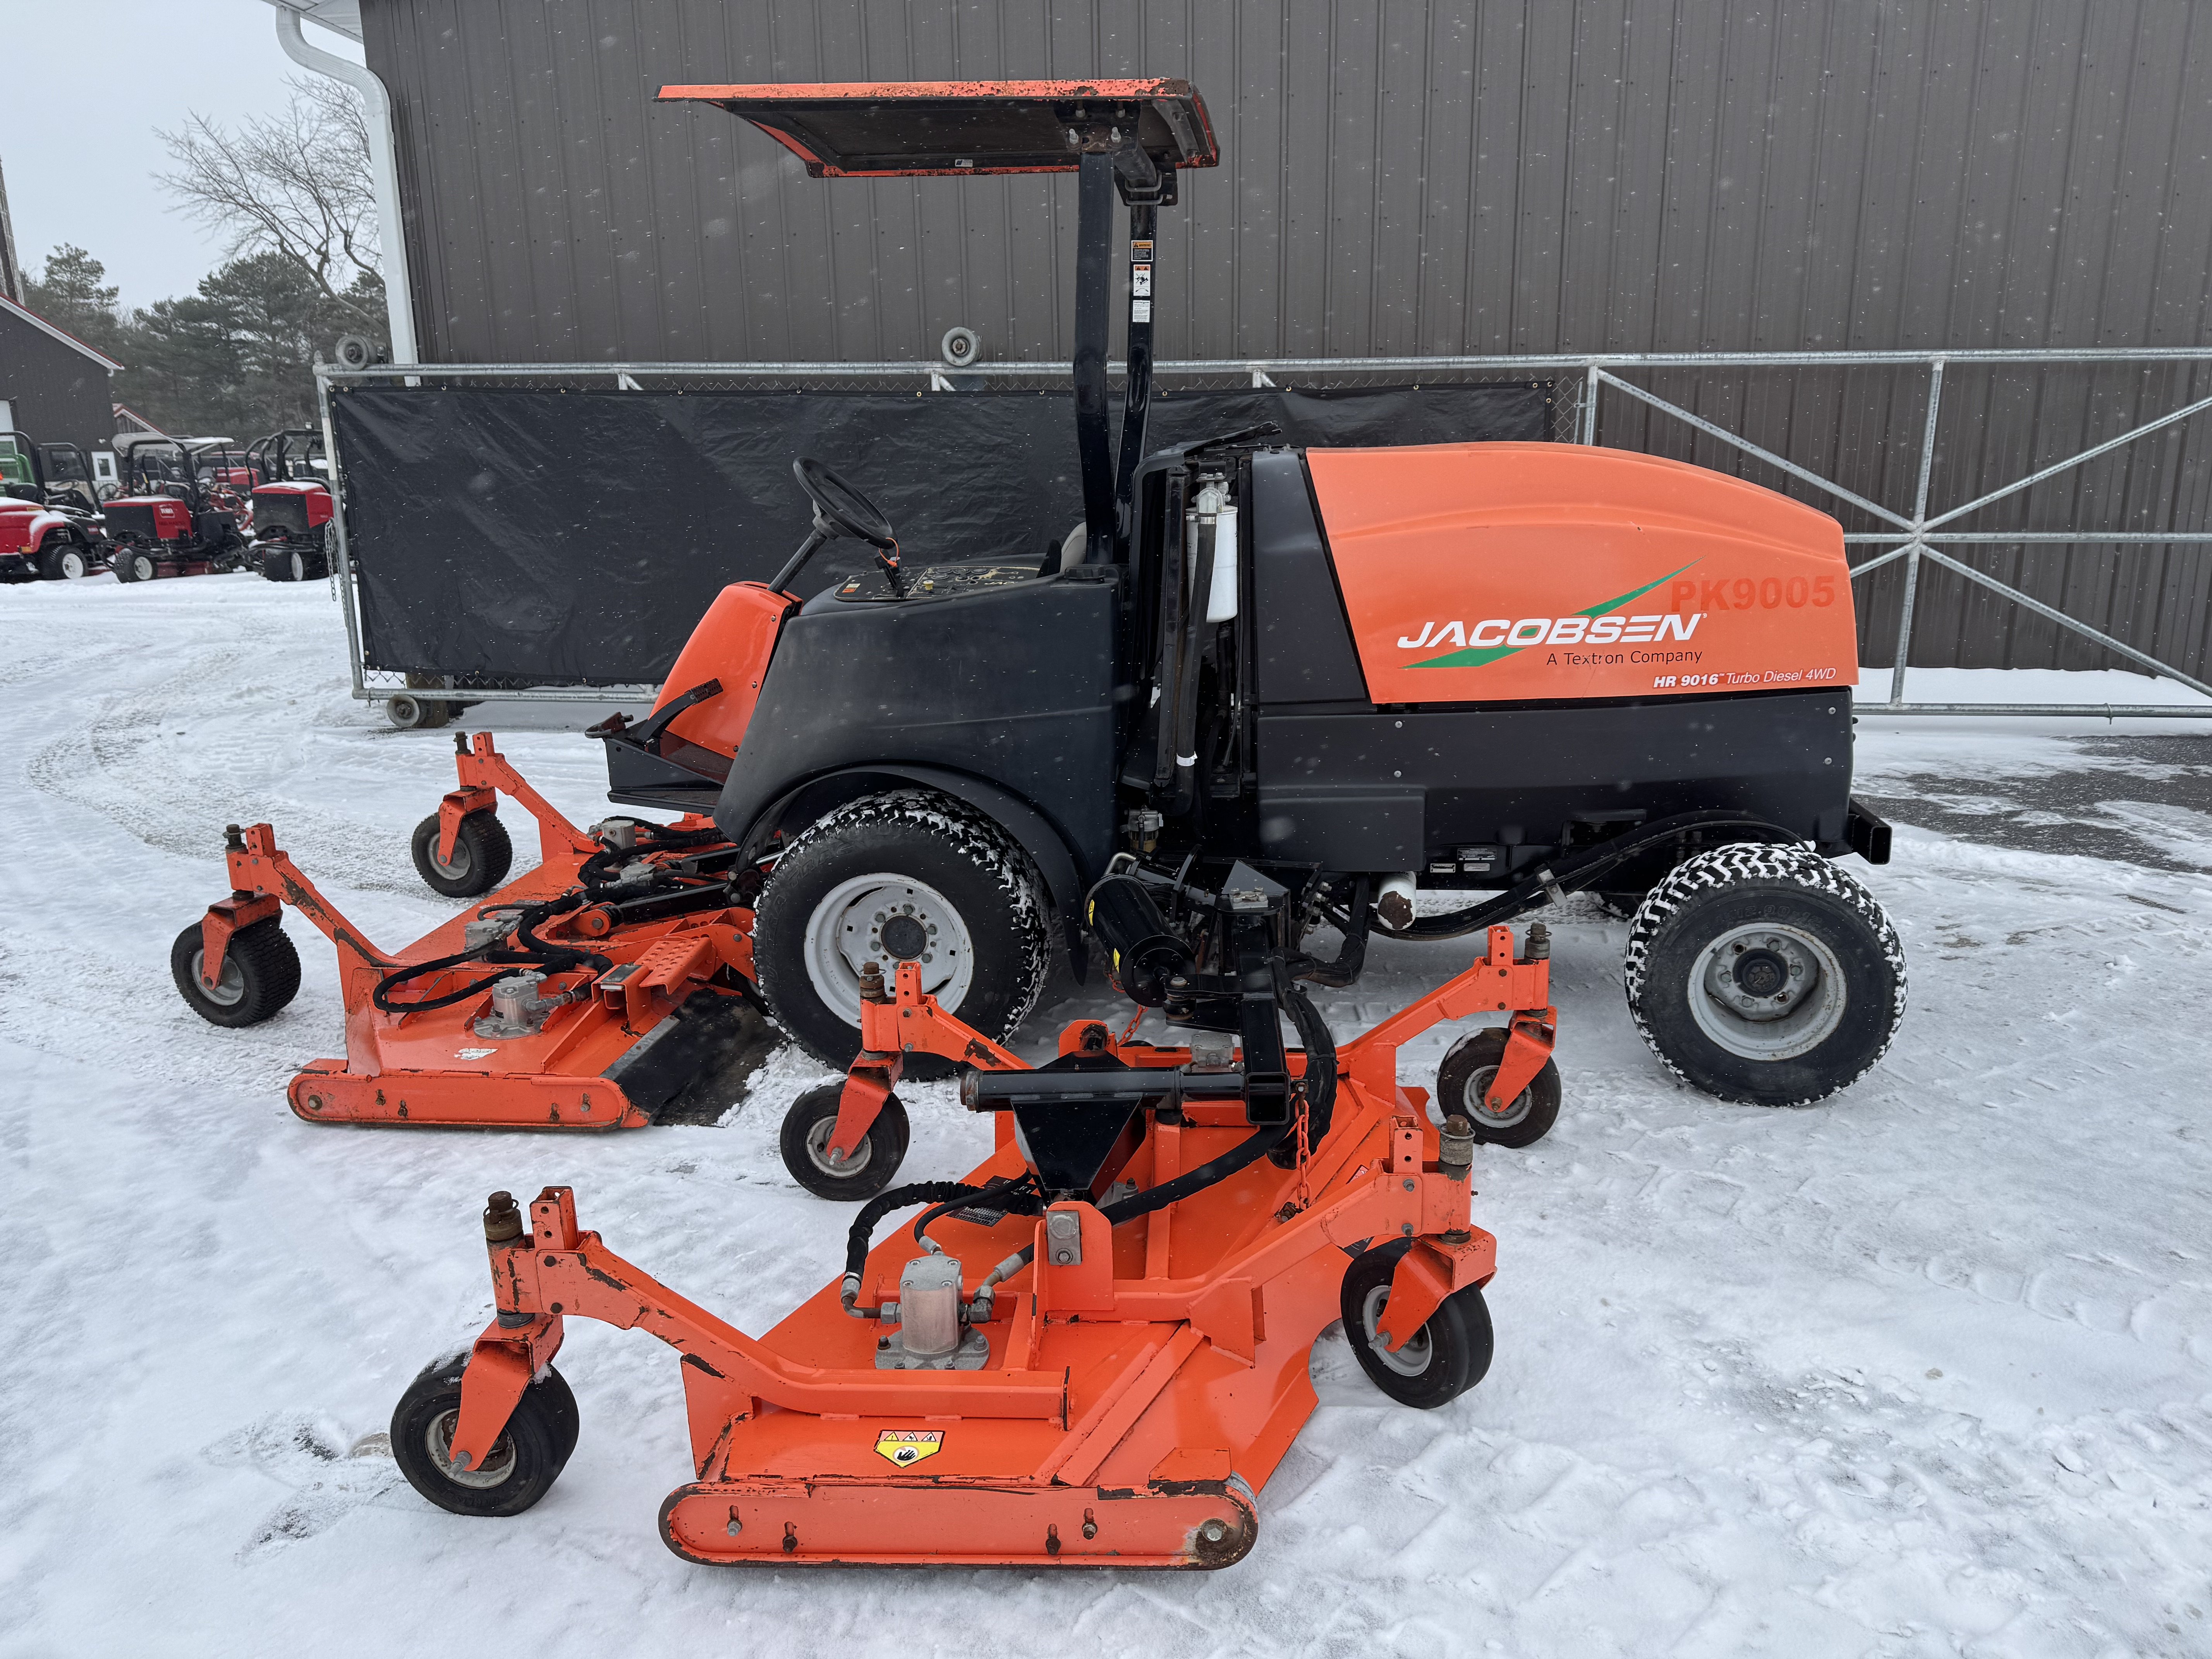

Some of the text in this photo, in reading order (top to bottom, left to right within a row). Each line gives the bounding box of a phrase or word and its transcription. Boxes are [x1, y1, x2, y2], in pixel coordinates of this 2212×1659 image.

[1671, 575, 1835, 612] PK9005
[1397, 613, 1702, 648] JACOBSEN
[1546, 651, 1702, 665] A Textron Company
[1653, 676, 1676, 688] HR
[1726, 671, 1760, 684] Turbo
[1764, 669, 1802, 682] Diesel
[1805, 668, 1836, 680] 4WD
